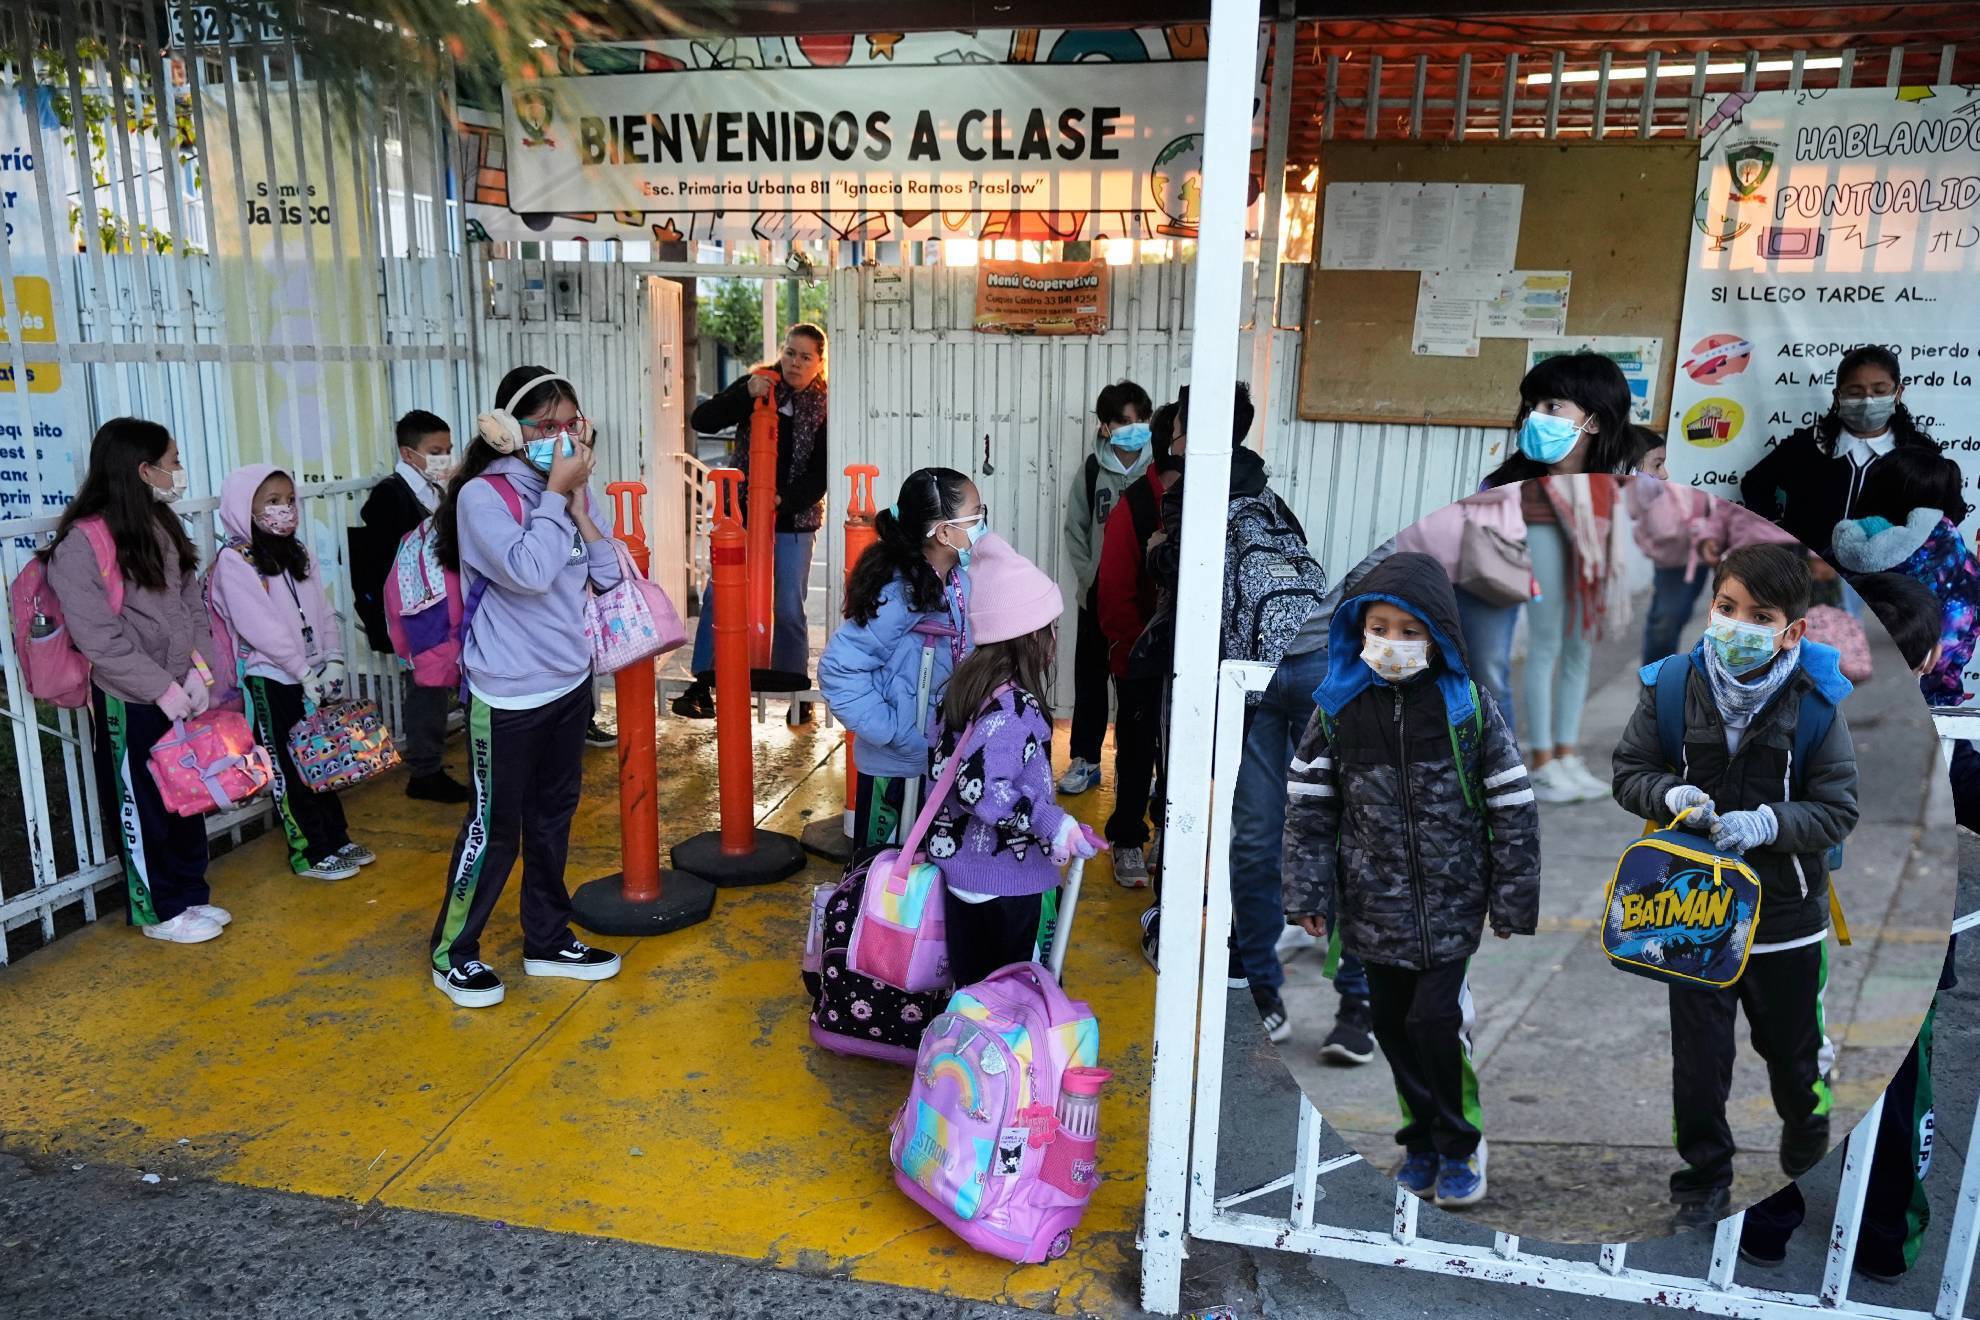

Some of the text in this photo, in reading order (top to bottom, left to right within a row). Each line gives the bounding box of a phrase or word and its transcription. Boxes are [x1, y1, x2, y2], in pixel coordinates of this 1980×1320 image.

[580, 107, 1121, 165] BIENVENIDOS A CLASE
[256, 182, 316, 197] Sms
[643, 178, 1044, 198] Esc. Primaria Urbana 811 “Ignacio Ramos Praslow”
[987, 271, 1099, 291] Menú Cooperativa
[1711, 286, 1727, 304] SI
[1737, 286, 1806, 303] LLEGO
[1816, 286, 1885, 303] TARDE
[1911, 341, 1969, 360] pierdo
[1775, 372, 1800, 385] AL
[1901, 370, 1945, 387] erdo
[1952, 370, 1972, 387] la
[1768, 411, 1792, 424] AL
[1691, 470, 1738, 486] ¿Qué
[1621, 887, 1733, 933] BATMAN
